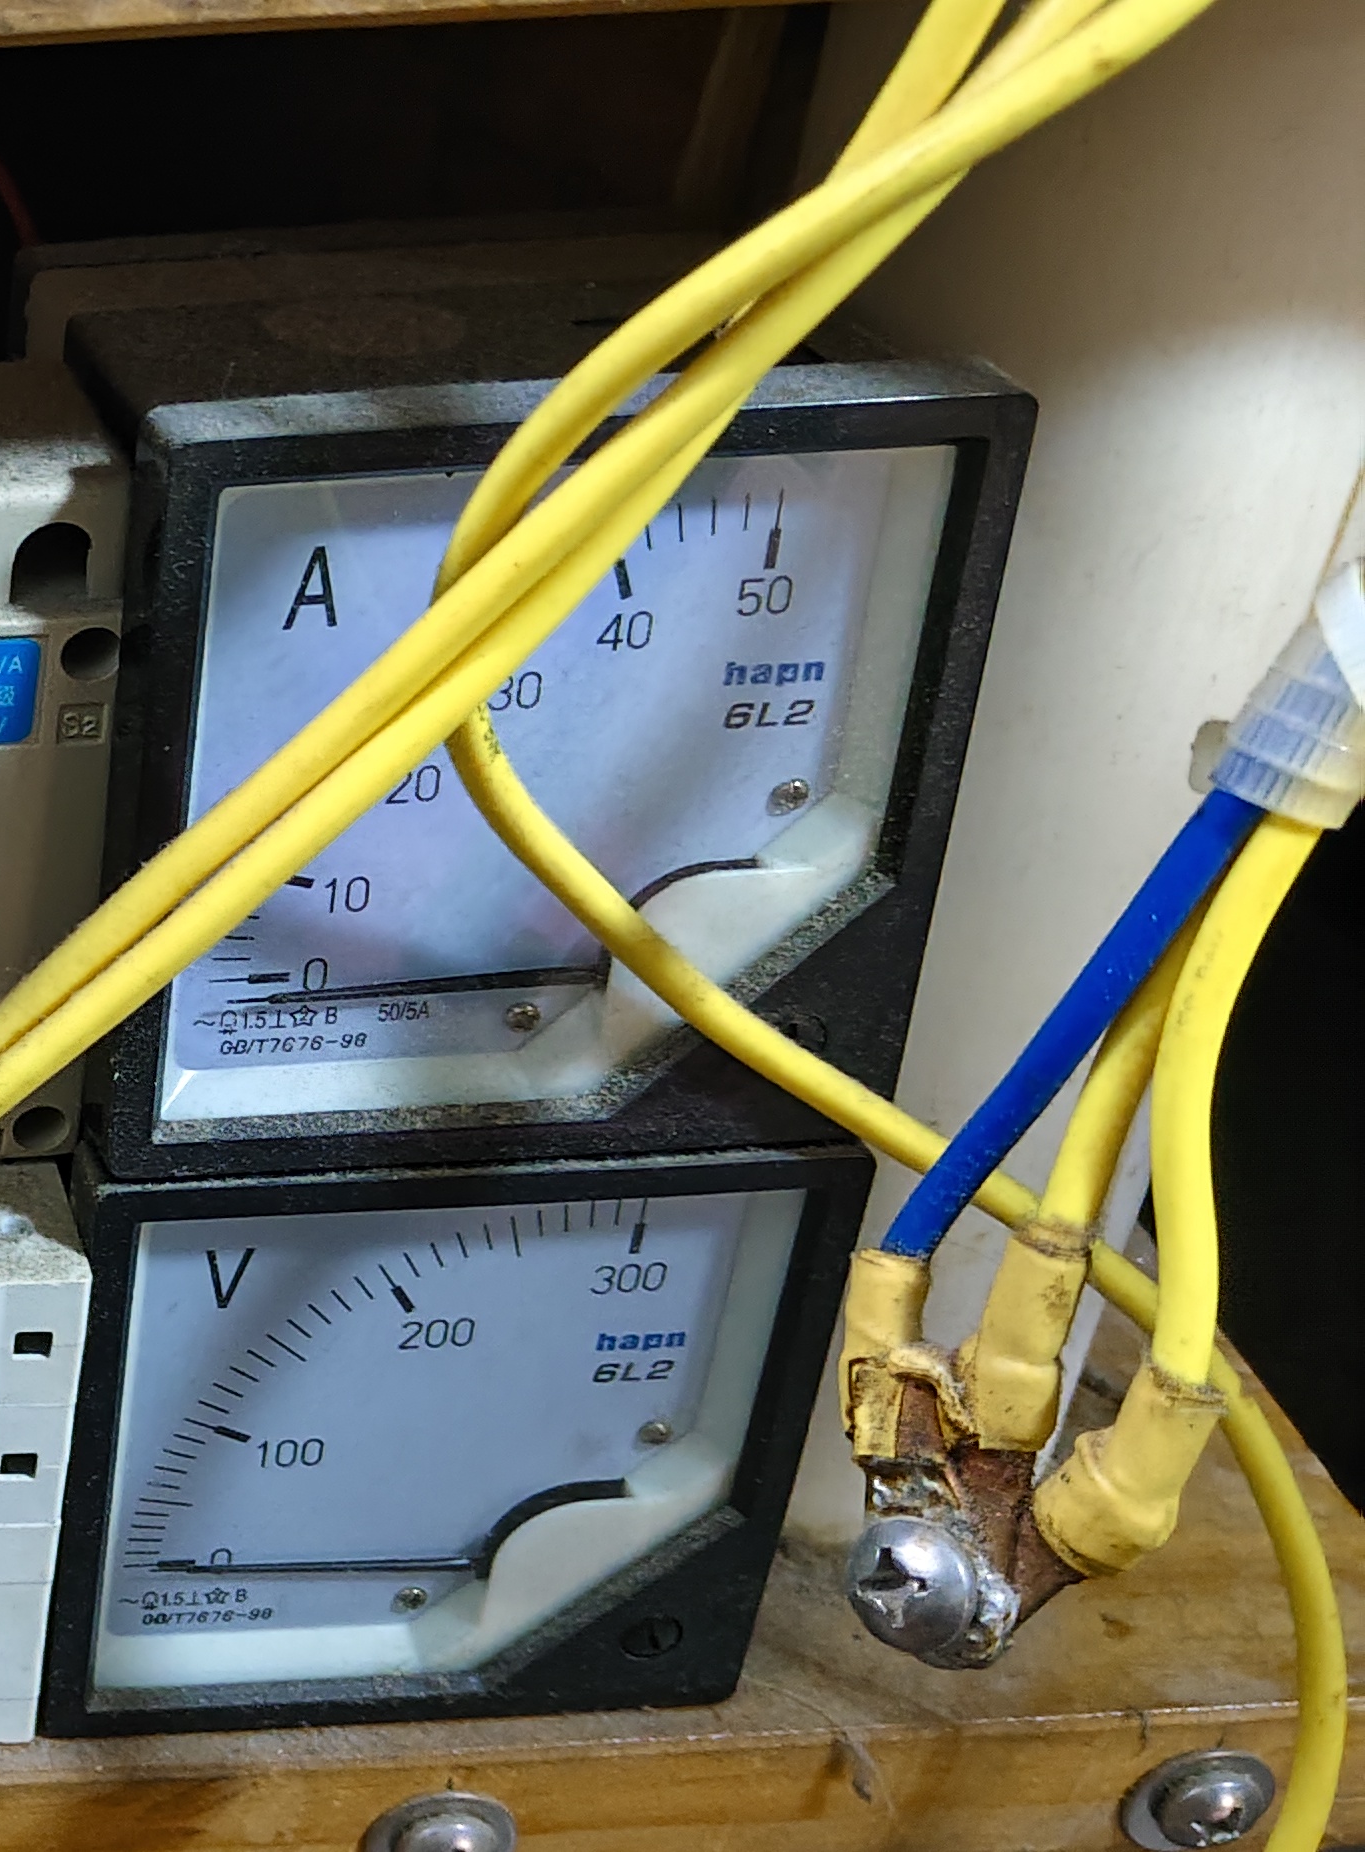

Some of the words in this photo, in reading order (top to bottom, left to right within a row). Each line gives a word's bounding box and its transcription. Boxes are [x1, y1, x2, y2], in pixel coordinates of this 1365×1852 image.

[282, 545, 339, 631] A
[736, 575, 794, 617] 50
[596, 610, 654, 652] 40
[487, 671, 542, 711] 30
[60, 711, 98, 737] S2
[723, 699, 816, 730] 6L2
[385, 765, 441, 805] 20
[324, 876, 371, 914] 10
[302, 957, 329, 991] 0
[377, 1002, 430, 1023] 50/5A
[206, 1248, 256, 1309] V
[589, 1261, 668, 1295] 300
[397, 1318, 476, 1351] 200
[591, 1359, 675, 1383] 6L2
[256, 1438, 325, 1468] 100
